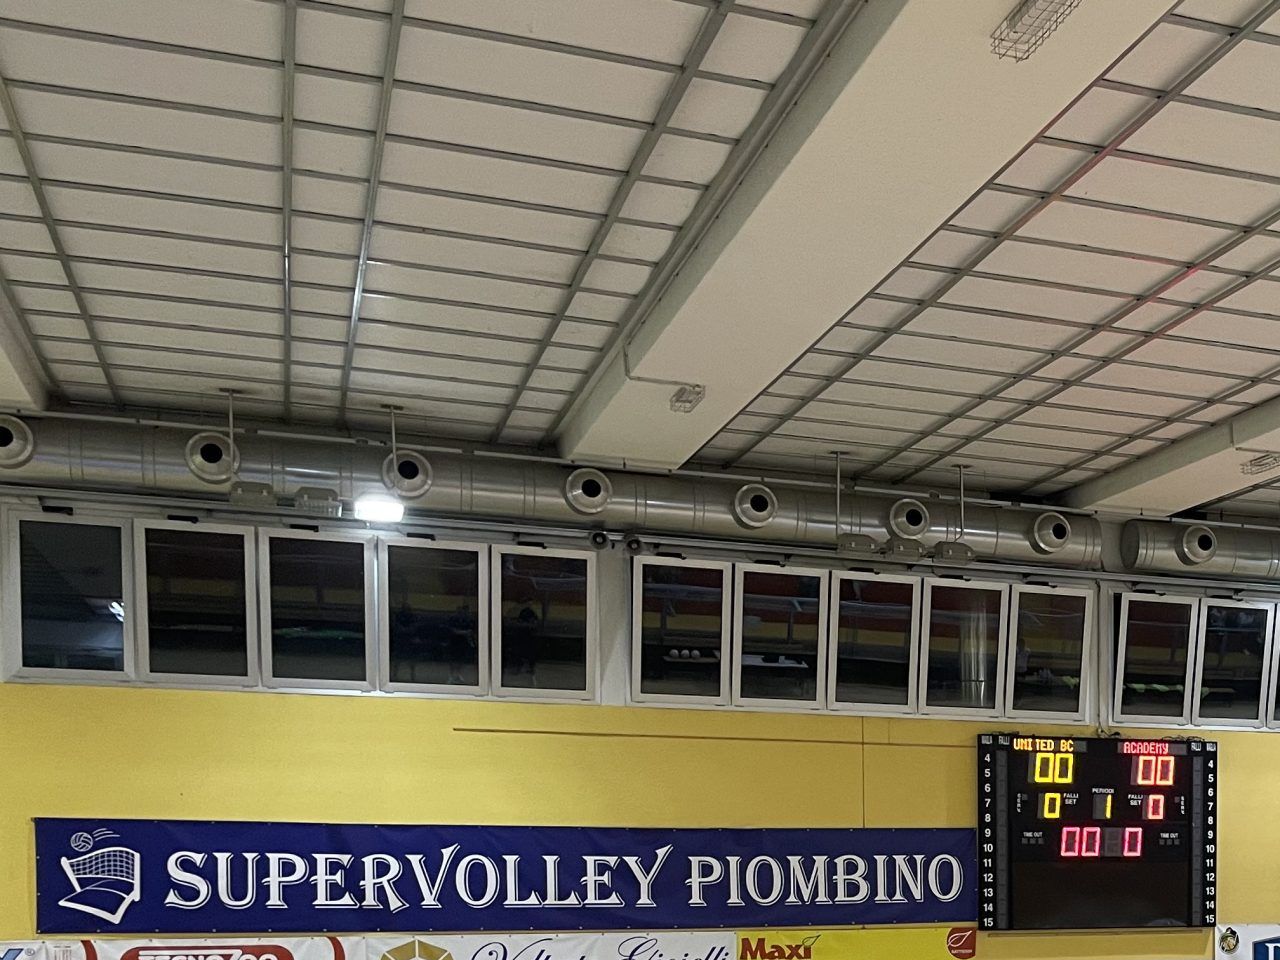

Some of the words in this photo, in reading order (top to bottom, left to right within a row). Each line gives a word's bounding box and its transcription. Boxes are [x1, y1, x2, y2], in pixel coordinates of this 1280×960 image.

[1060, 740, 1074, 752] BC
[1123, 741, 1169, 754] ACADEMY
[984, 753, 991, 762] 4
[1034, 752, 1074, 784] 00
[1207, 760, 1214, 768] 4
[984, 769, 991, 778] 5
[1137, 755, 1175, 786] 00
[1207, 774, 1214, 783] 5
[984, 783, 991, 793] 6
[1207, 788, 1214, 797] 6
[984, 798, 991, 807] 7
[1043, 792, 1061, 819] 0
[1105, 794, 1112, 819] 1
[1147, 794, 1165, 820] 0
[1207, 802, 1214, 811] 7
[984, 813, 991, 823] 8
[1207, 816, 1214, 825] 8
[984, 828, 991, 838] 9
[1207, 830, 1214, 839] 9
[1123, 827, 1143, 857] 0
[983, 843, 994, 853] 10
[1206, 845, 1215, 853] 10
[983, 859, 994, 867] 11
[1206, 859, 1215, 867] 11
[162, 844, 675, 914] SUPERVOLLEY
[684, 854, 964, 907] PIOMBINO
[983, 873, 994, 882] 12
[1206, 873, 1215, 882] 12
[983, 888, 994, 897] 13
[1206, 887, 1215, 896] 13
[983, 903, 994, 912] 14
[1206, 901, 1215, 909] 14
[983, 918, 994, 927] 15
[1206, 915, 1215, 923] 15
[740, 935, 813, 960] Maxi
